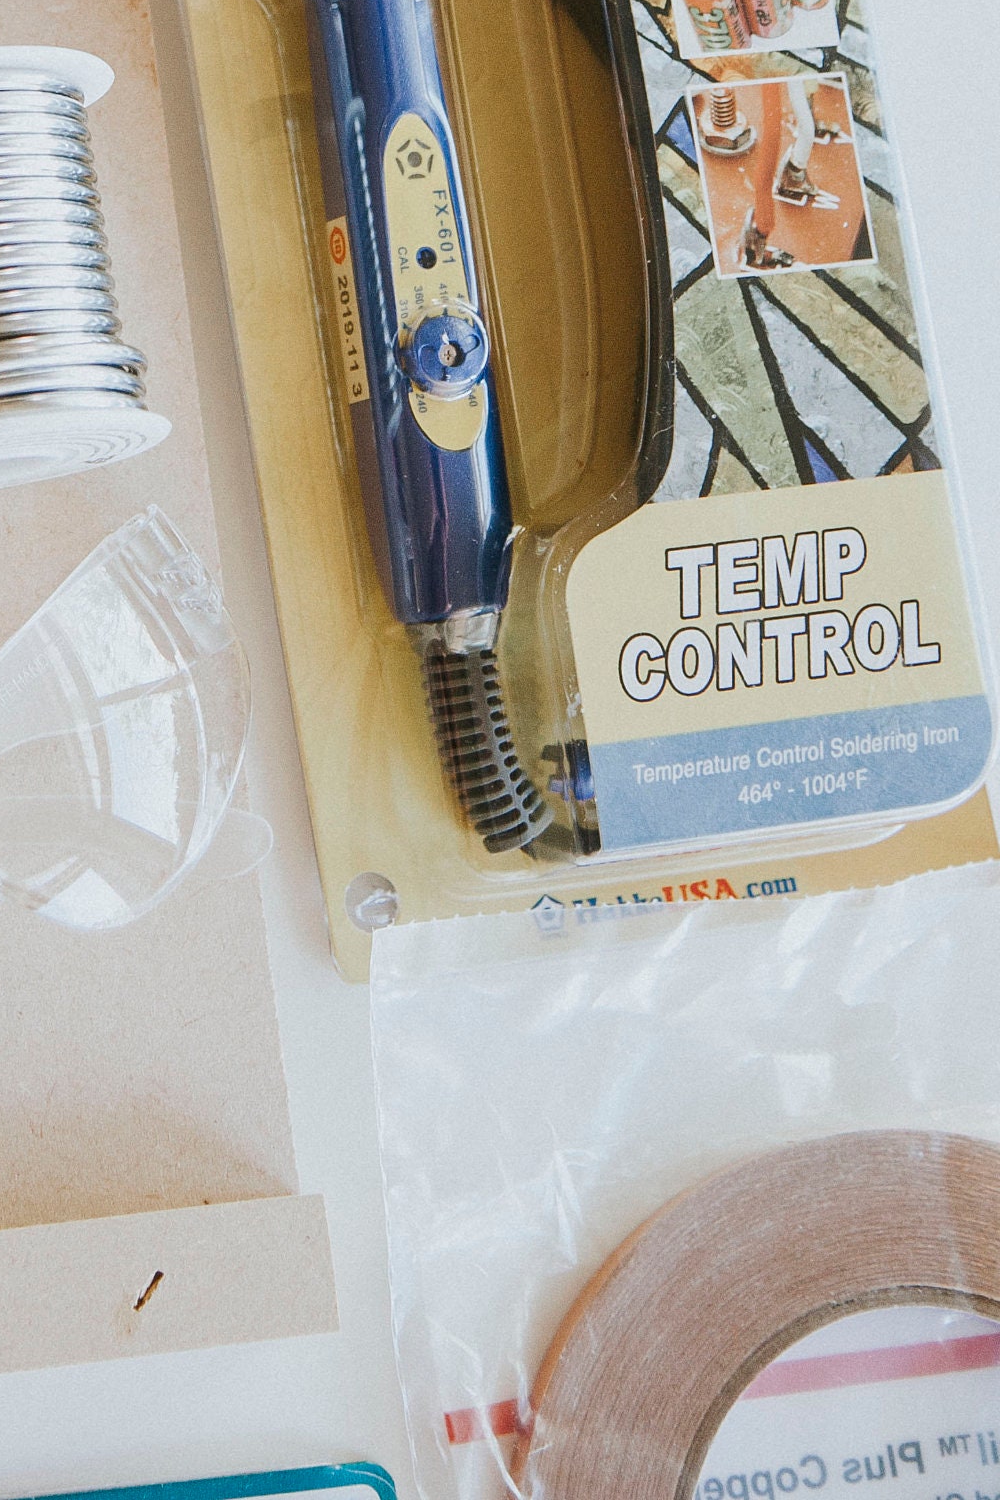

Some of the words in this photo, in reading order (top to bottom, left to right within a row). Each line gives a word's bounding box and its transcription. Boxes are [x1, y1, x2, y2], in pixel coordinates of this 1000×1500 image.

[432, 189, 456, 265] FX-601
[397, 247, 408, 274] CAL
[351, 382, 363, 397] 3
[414, 392, 427, 414] 240
[665, 527, 867, 619] TEMP
[618, 599, 941, 702] CONTROL
[632, 753, 750, 785] Temperature
[756, 743, 824, 768] Control
[830, 731, 918, 757] Soldering
[923, 726, 960, 746] Iron
[738, 780, 781, 805] 464°
[803, 768, 868, 798] 1004°F
